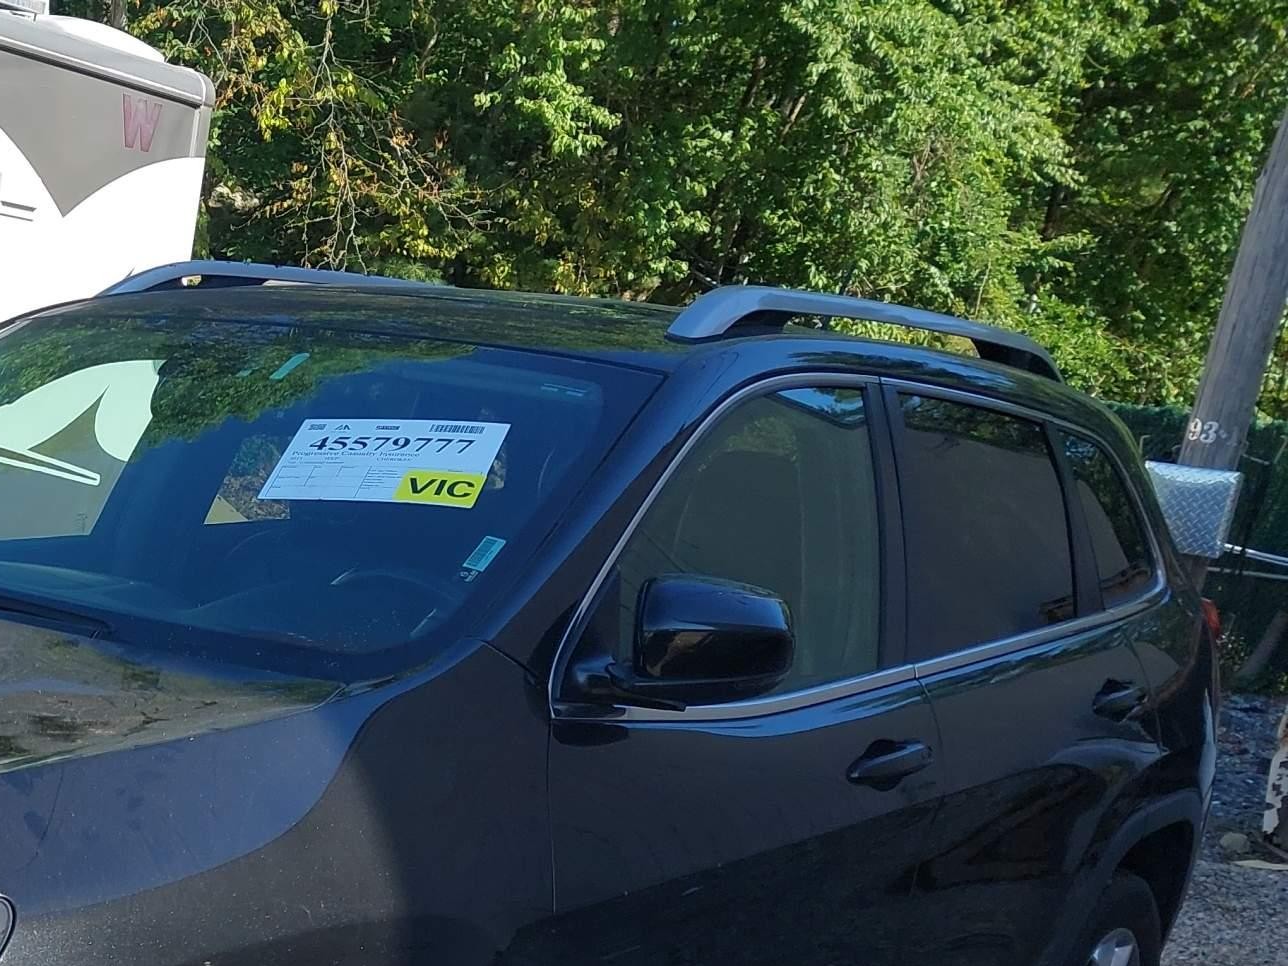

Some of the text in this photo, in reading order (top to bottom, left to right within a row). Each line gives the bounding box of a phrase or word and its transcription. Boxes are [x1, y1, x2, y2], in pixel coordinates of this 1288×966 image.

[122, 93, 163, 152] W
[309, 437, 476, 454] 45579777
[409, 477, 475, 498] VIC
